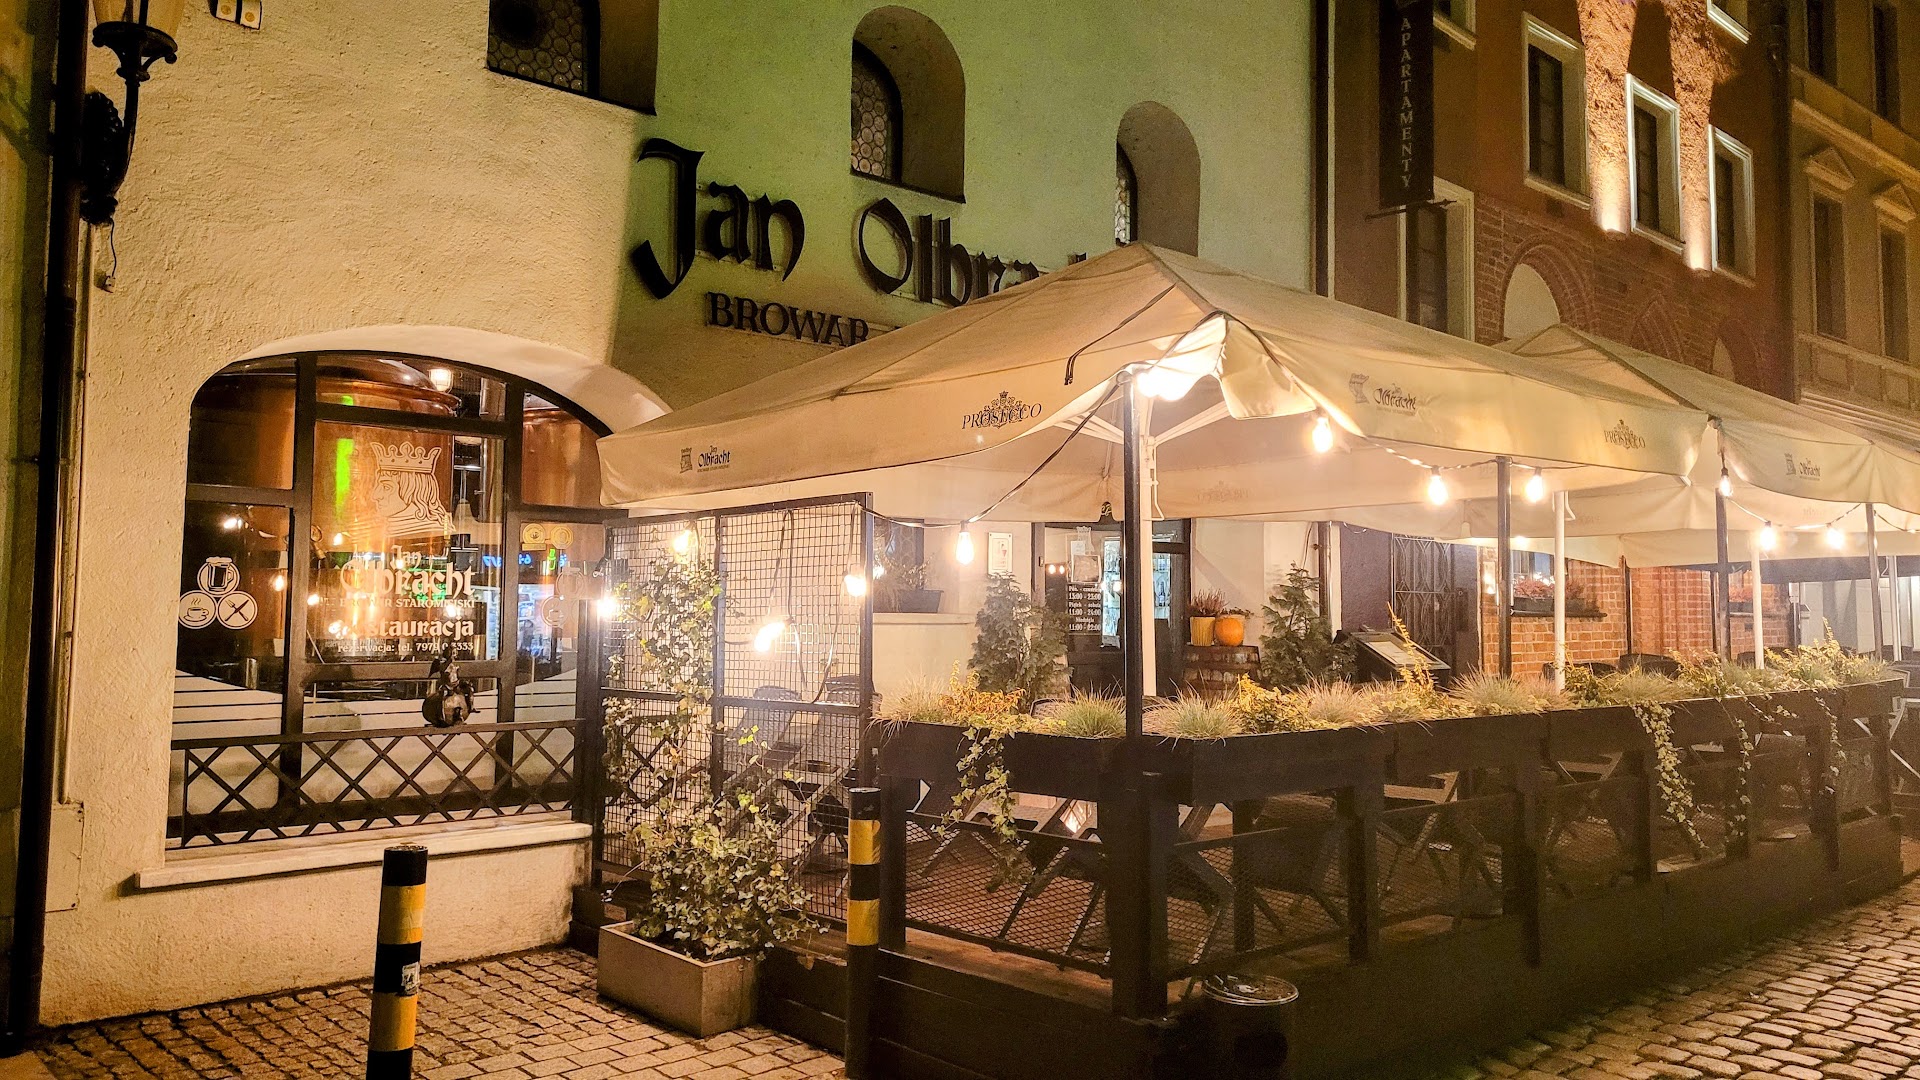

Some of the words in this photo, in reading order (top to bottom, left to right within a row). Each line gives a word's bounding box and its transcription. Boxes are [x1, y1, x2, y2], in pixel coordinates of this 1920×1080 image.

[1400, 17, 1413, 188] APARTAMENTY
[631, 137, 805, 300] Jan
[697, 449, 731, 468] Olbracht
[390, 545, 422, 570] Jan
